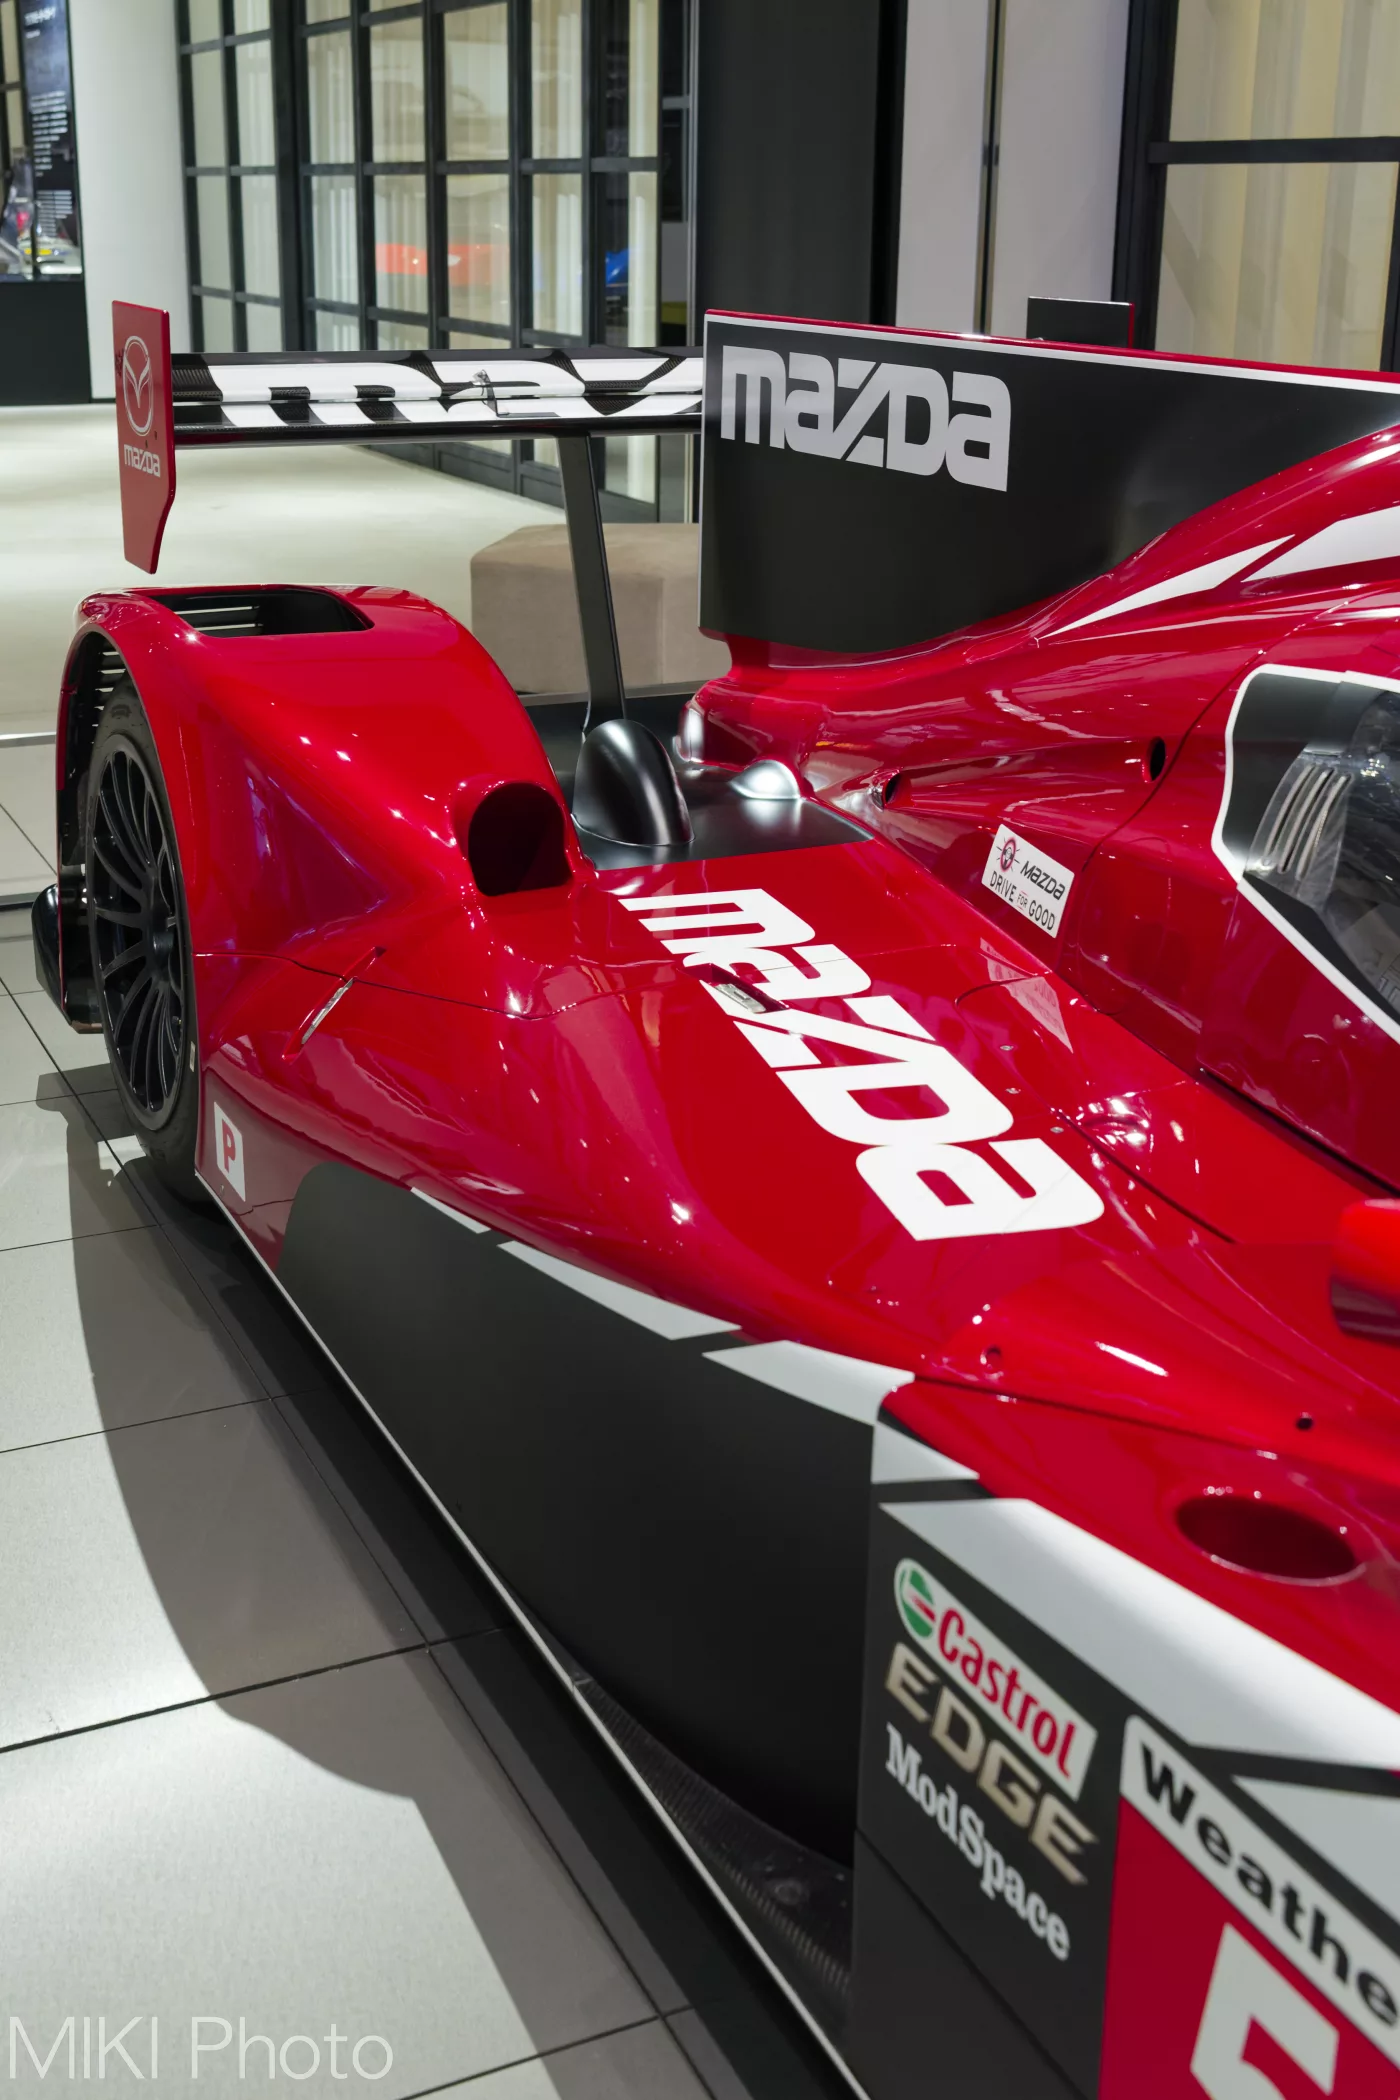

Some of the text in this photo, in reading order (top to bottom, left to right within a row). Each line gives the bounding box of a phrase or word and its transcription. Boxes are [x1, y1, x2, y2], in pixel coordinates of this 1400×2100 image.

[990, 871, 1055, 930] DRIVE FOR GOOD
[222, 1118, 236, 1174] P
[885, 1642, 1099, 1885] EDGE
[938, 1608, 1077, 1779] Castrol
[886, 1722, 1070, 1961] ModSpace
